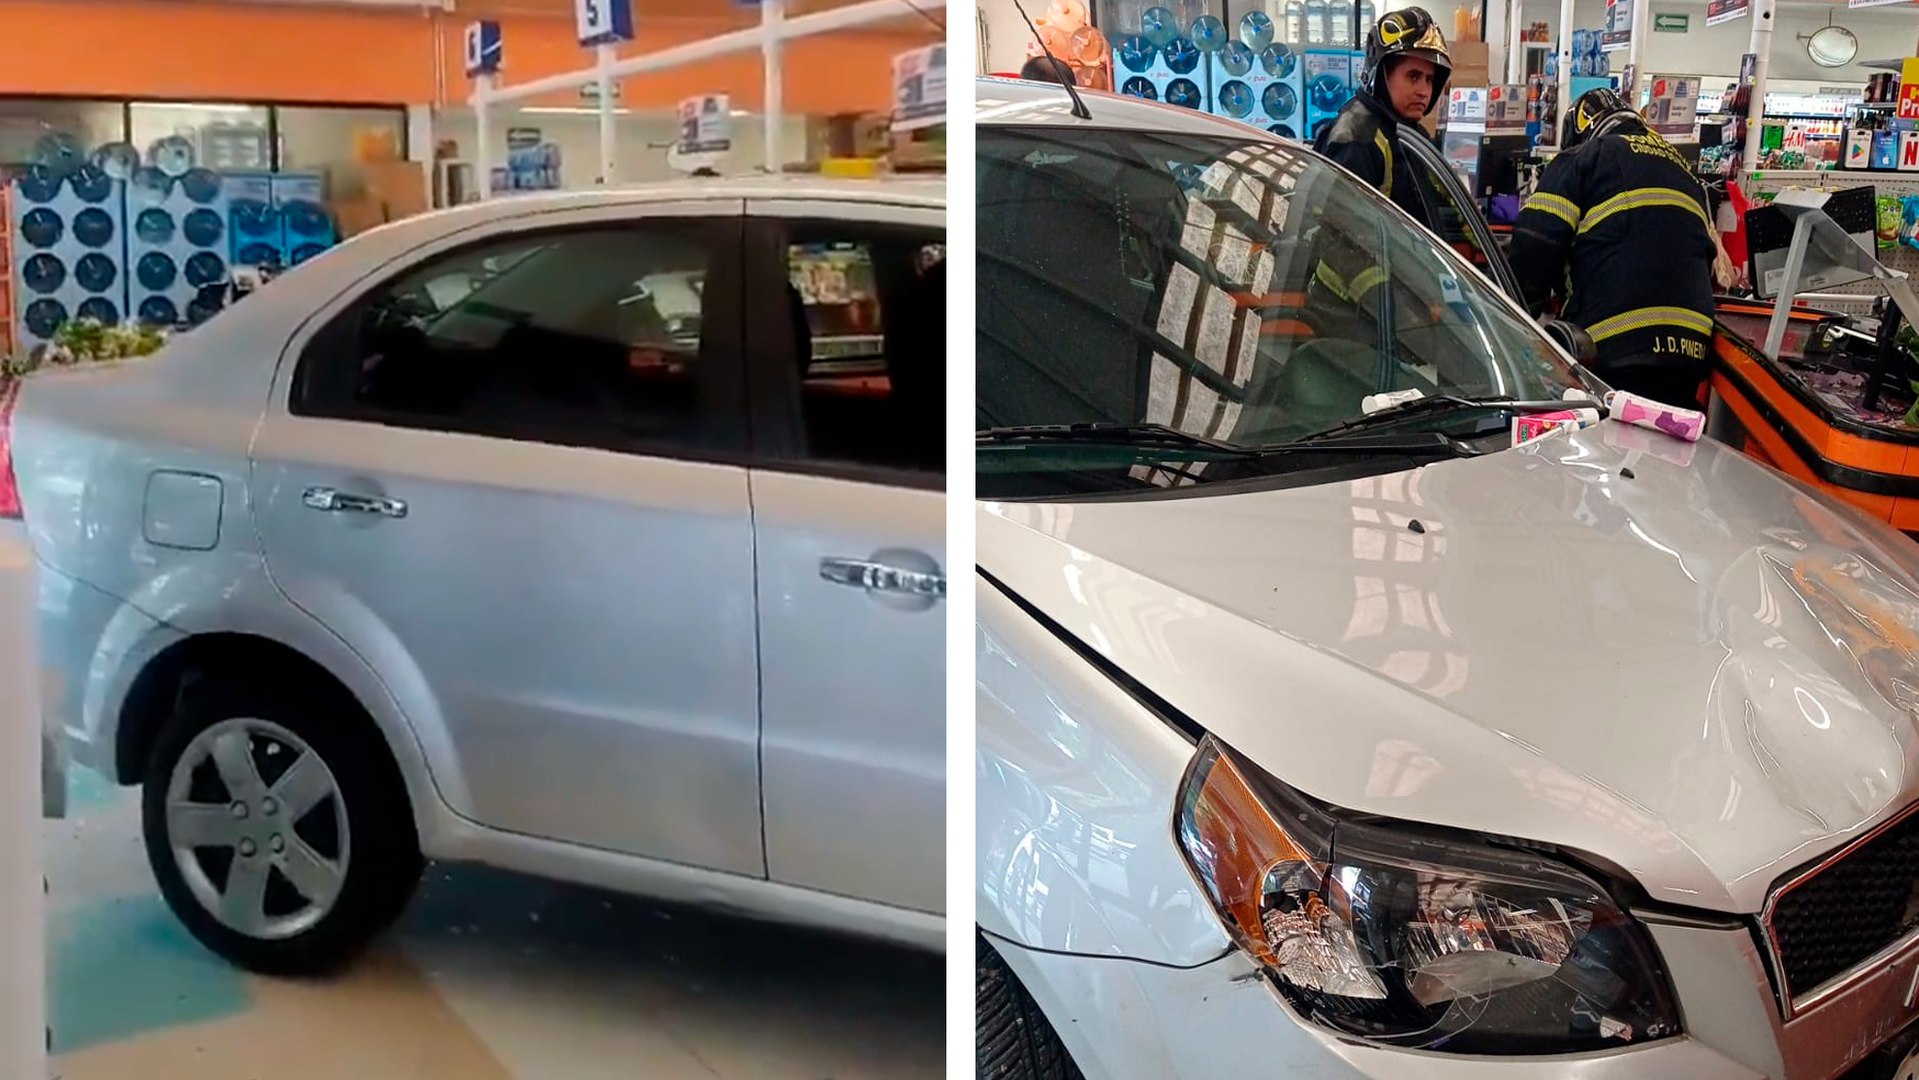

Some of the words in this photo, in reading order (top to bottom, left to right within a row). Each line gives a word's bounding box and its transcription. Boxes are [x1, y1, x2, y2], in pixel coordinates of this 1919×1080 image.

[587, 0, 598, 26] 5
[1652, 336, 1665, 353] J.
[1667, 336, 1679, 353] D.
